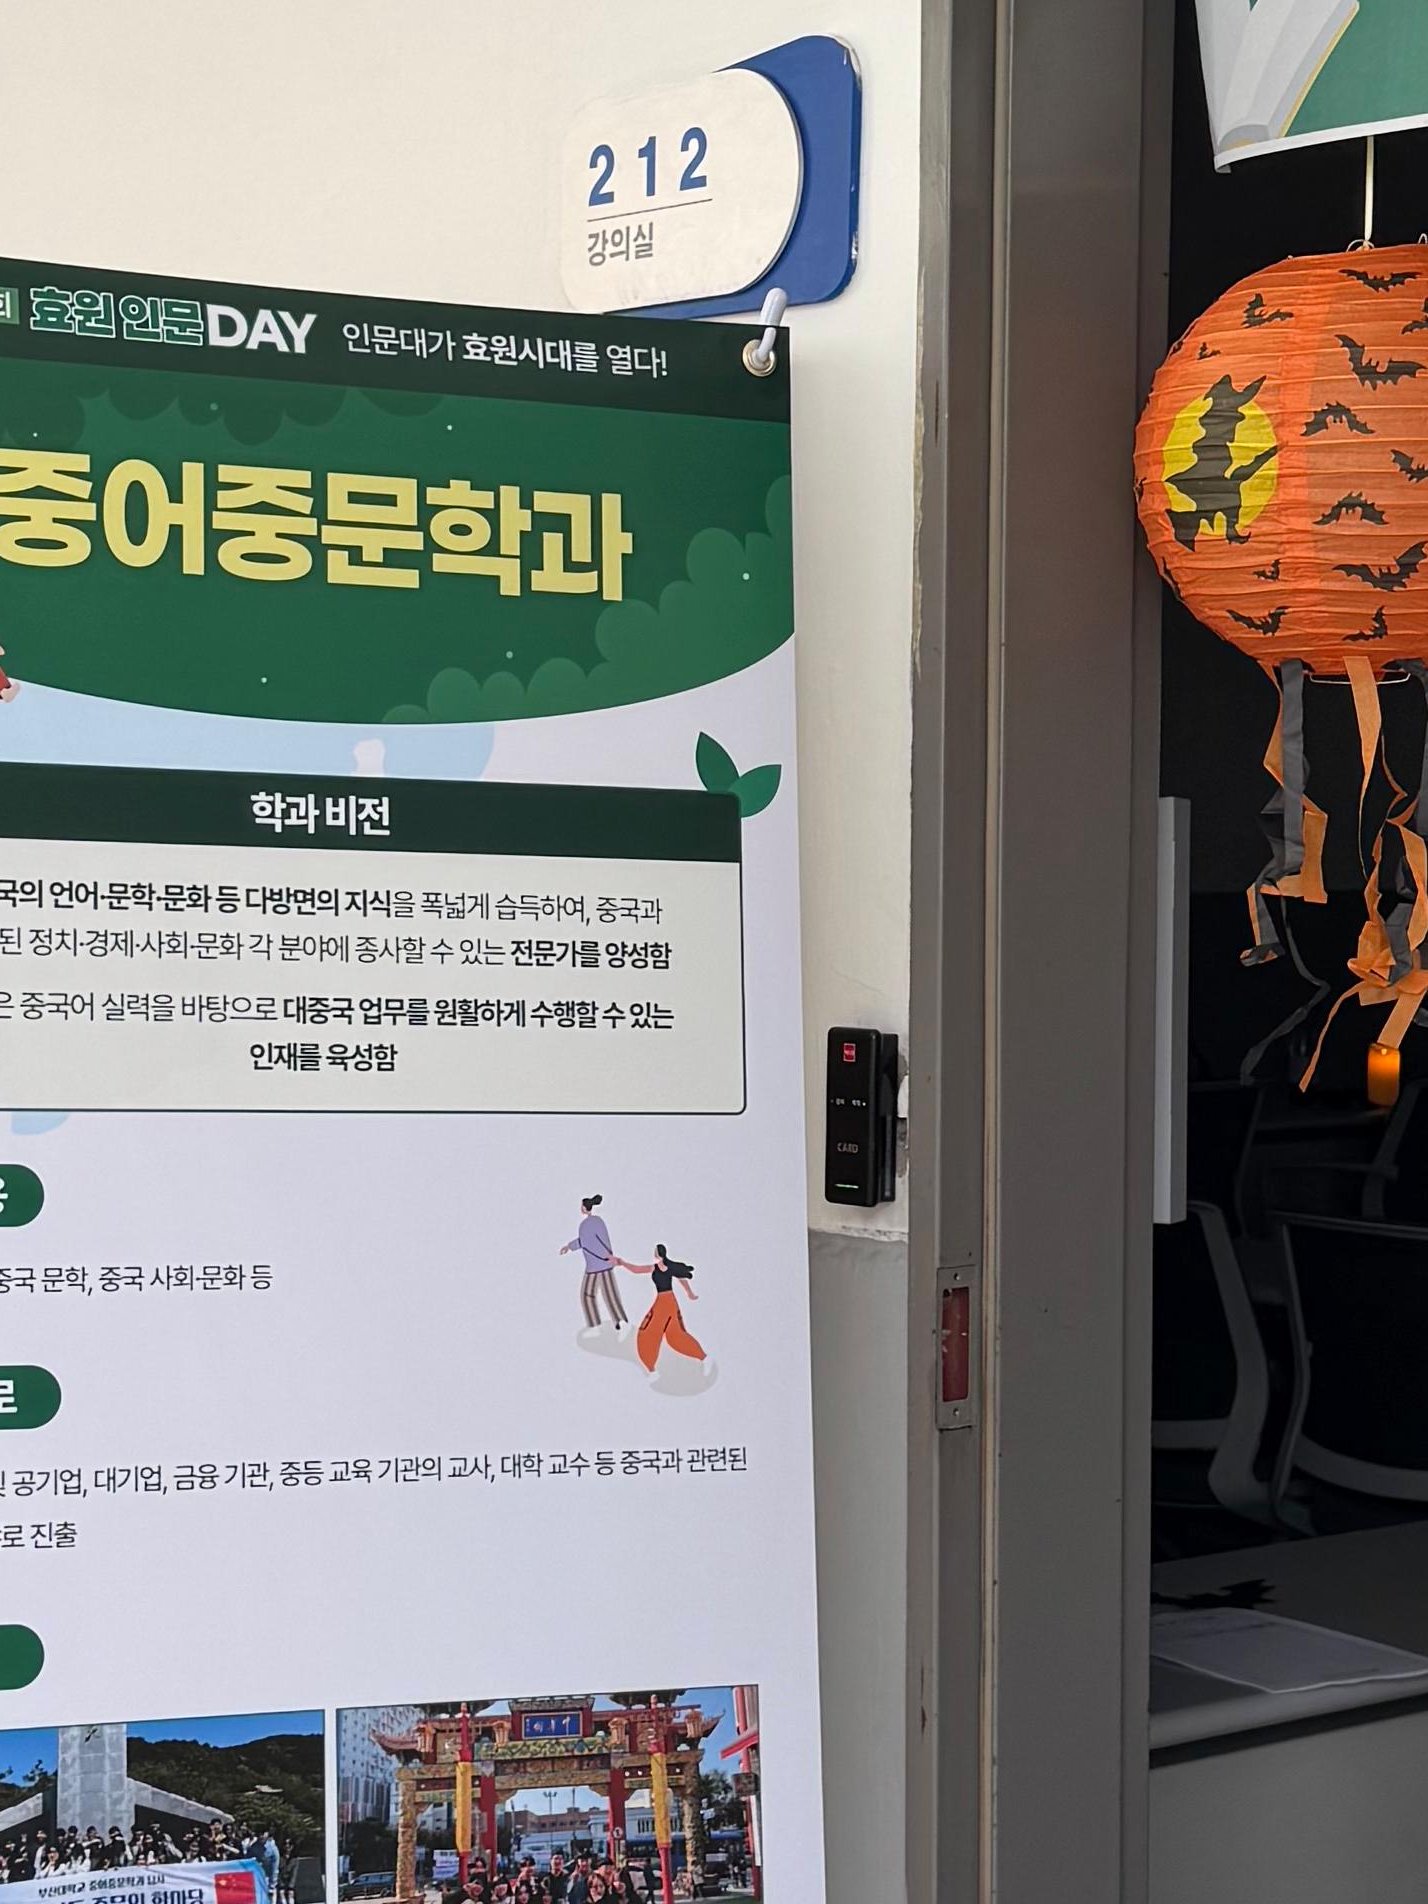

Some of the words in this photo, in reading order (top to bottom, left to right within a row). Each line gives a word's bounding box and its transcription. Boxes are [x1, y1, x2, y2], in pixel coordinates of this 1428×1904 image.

[587, 222, 654, 267] 강의실
[343, 323, 456, 360] 인문대가
[463, 333, 599, 372] 효원시대를
[607, 345, 667, 378] 열다!
[251, 792, 319, 833] 학과
[326, 796, 390, 835] 비전
[216, 886, 240, 913] 등
[246, 887, 338, 916] 다방면의
[345, 890, 415, 918] 지식을
[421, 893, 488, 920] 폭넓게
[495, 894, 590, 926] 습득하여,
[596, 897, 662, 924] 중국과
[249, 934, 273, 960] 각
[279, 935, 348, 962] 분야에
[355, 937, 426, 964] 종사할
[431, 939, 454, 964] 수
[460, 939, 505, 965] 있는
[511, 940, 601, 967] 전문가를
[606, 942, 672, 969] 양성함
[20, 993, 93, 1021] 중국어
[102, 994, 175, 1021] 실력을
[182, 994, 278, 1022] 바탕으로
[284, 996, 354, 1025] 대중국
[359, 998, 430, 1025] 업무를
[434, 999, 525, 1027] 원활하게
[531, 1001, 599, 1029] 수행할
[601, 1003, 626, 1029] 수
[630, 1002, 674, 1028] 있는
[250, 1043, 322, 1071] 인재를
[326, 1044, 398, 1071] 육성함
[42, 1267, 92, 1296] 문학,
[99, 1267, 144, 1292] 중국
[251, 1265, 272, 1289] 등
[13, 1468, 87, 1497] 공기업,
[95, 1466, 167, 1495] 대기업,
[174, 1464, 219, 1490] 금융
[225, 1462, 273, 1491] 기관,
[280, 1461, 324, 1486] 중등
[329, 1459, 372, 1483] 교육
[379, 1457, 441, 1482] 기관의
[448, 1455, 494, 1483] 교사,
[502, 1453, 543, 1478] 대학
[549, 1453, 590, 1477] 교수
[595, 1452, 615, 1475] 등
[621, 1449, 682, 1474] 중국과
[688, 1448, 746, 1472] 관련된
[31, 1522, 77, 1548] 진출
